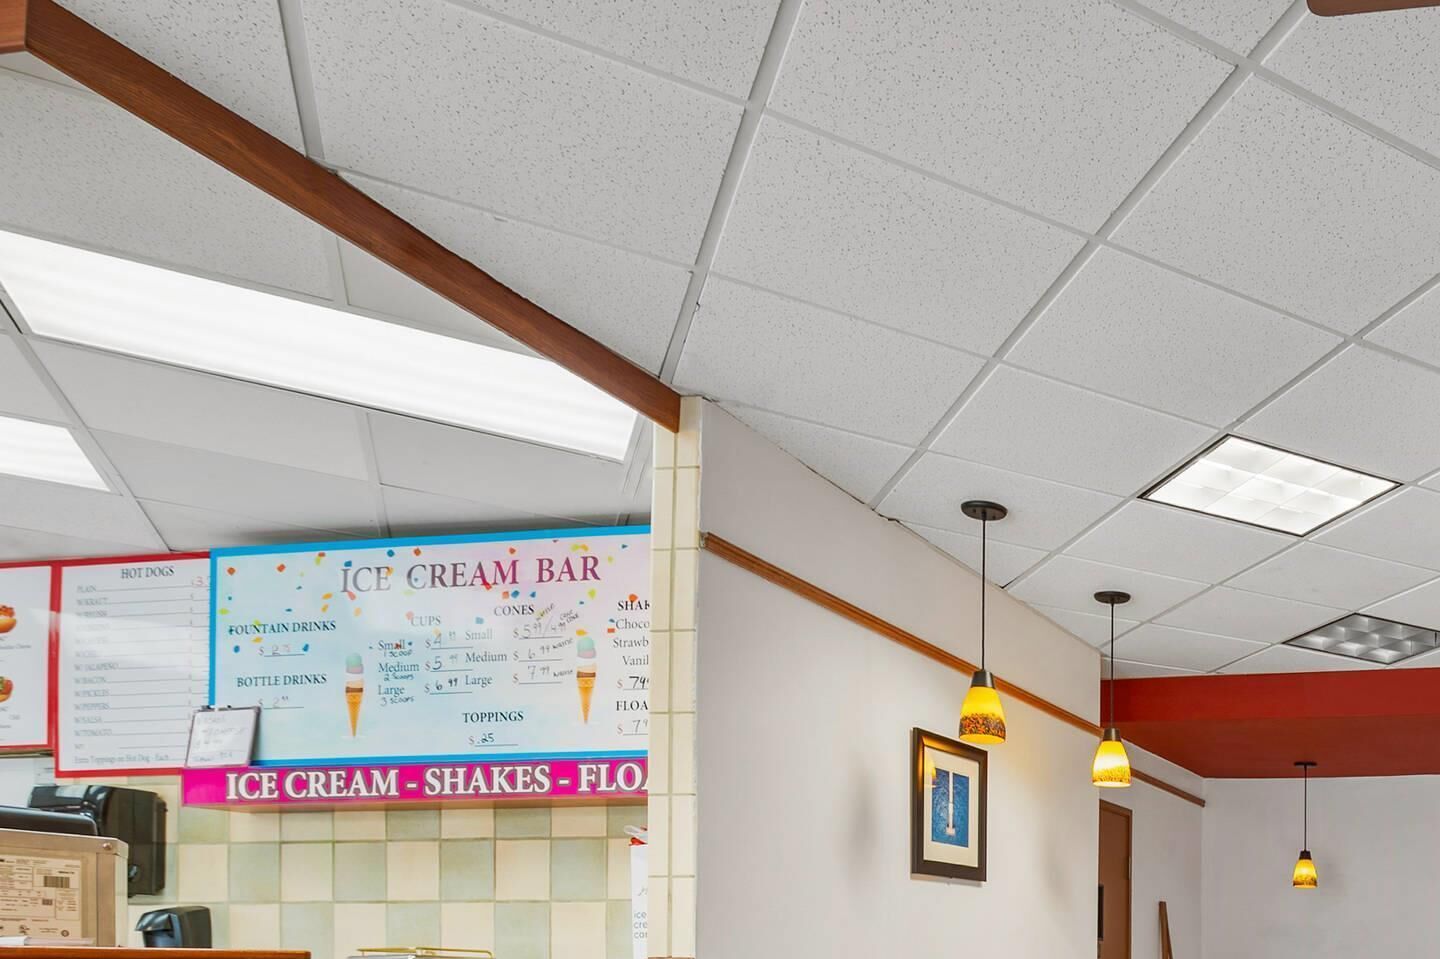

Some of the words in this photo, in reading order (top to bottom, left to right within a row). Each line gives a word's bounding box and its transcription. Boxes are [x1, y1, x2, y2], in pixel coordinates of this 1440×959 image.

[121, 567, 142, 579] HOT
[145, 565, 175, 578] DOGS
[340, 566, 392, 593] ICE
[406, 559, 520, 590] CREAM
[535, 555, 601, 584] BAR
[494, 604, 535, 616] CONES
[228, 622, 290, 635] FOUNTAIN
[292, 620, 337, 633] DRINKS
[410, 615, 441, 627] CUPS
[615, 618, 650, 631] Choco
[465, 628, 493, 641] Small
[378, 639, 405, 650] Small
[613, 637, 649, 649] Strawb
[465, 651, 508, 663] Medium
[378, 662, 420, 673] Medium
[237, 675, 281, 687] BOTTLE
[283, 673, 328, 685] DRINKS
[465, 675, 493, 688] Large
[378, 685, 405, 698] Large
[616, 700, 648, 712] FLOA
[462, 710, 524, 723] TOPPINGS
[225, 771, 281, 802] ICE
[283, 768, 398, 799] CREAM
[424, 763, 551, 797] SHAKES
[578, 762, 648, 792] FLO
